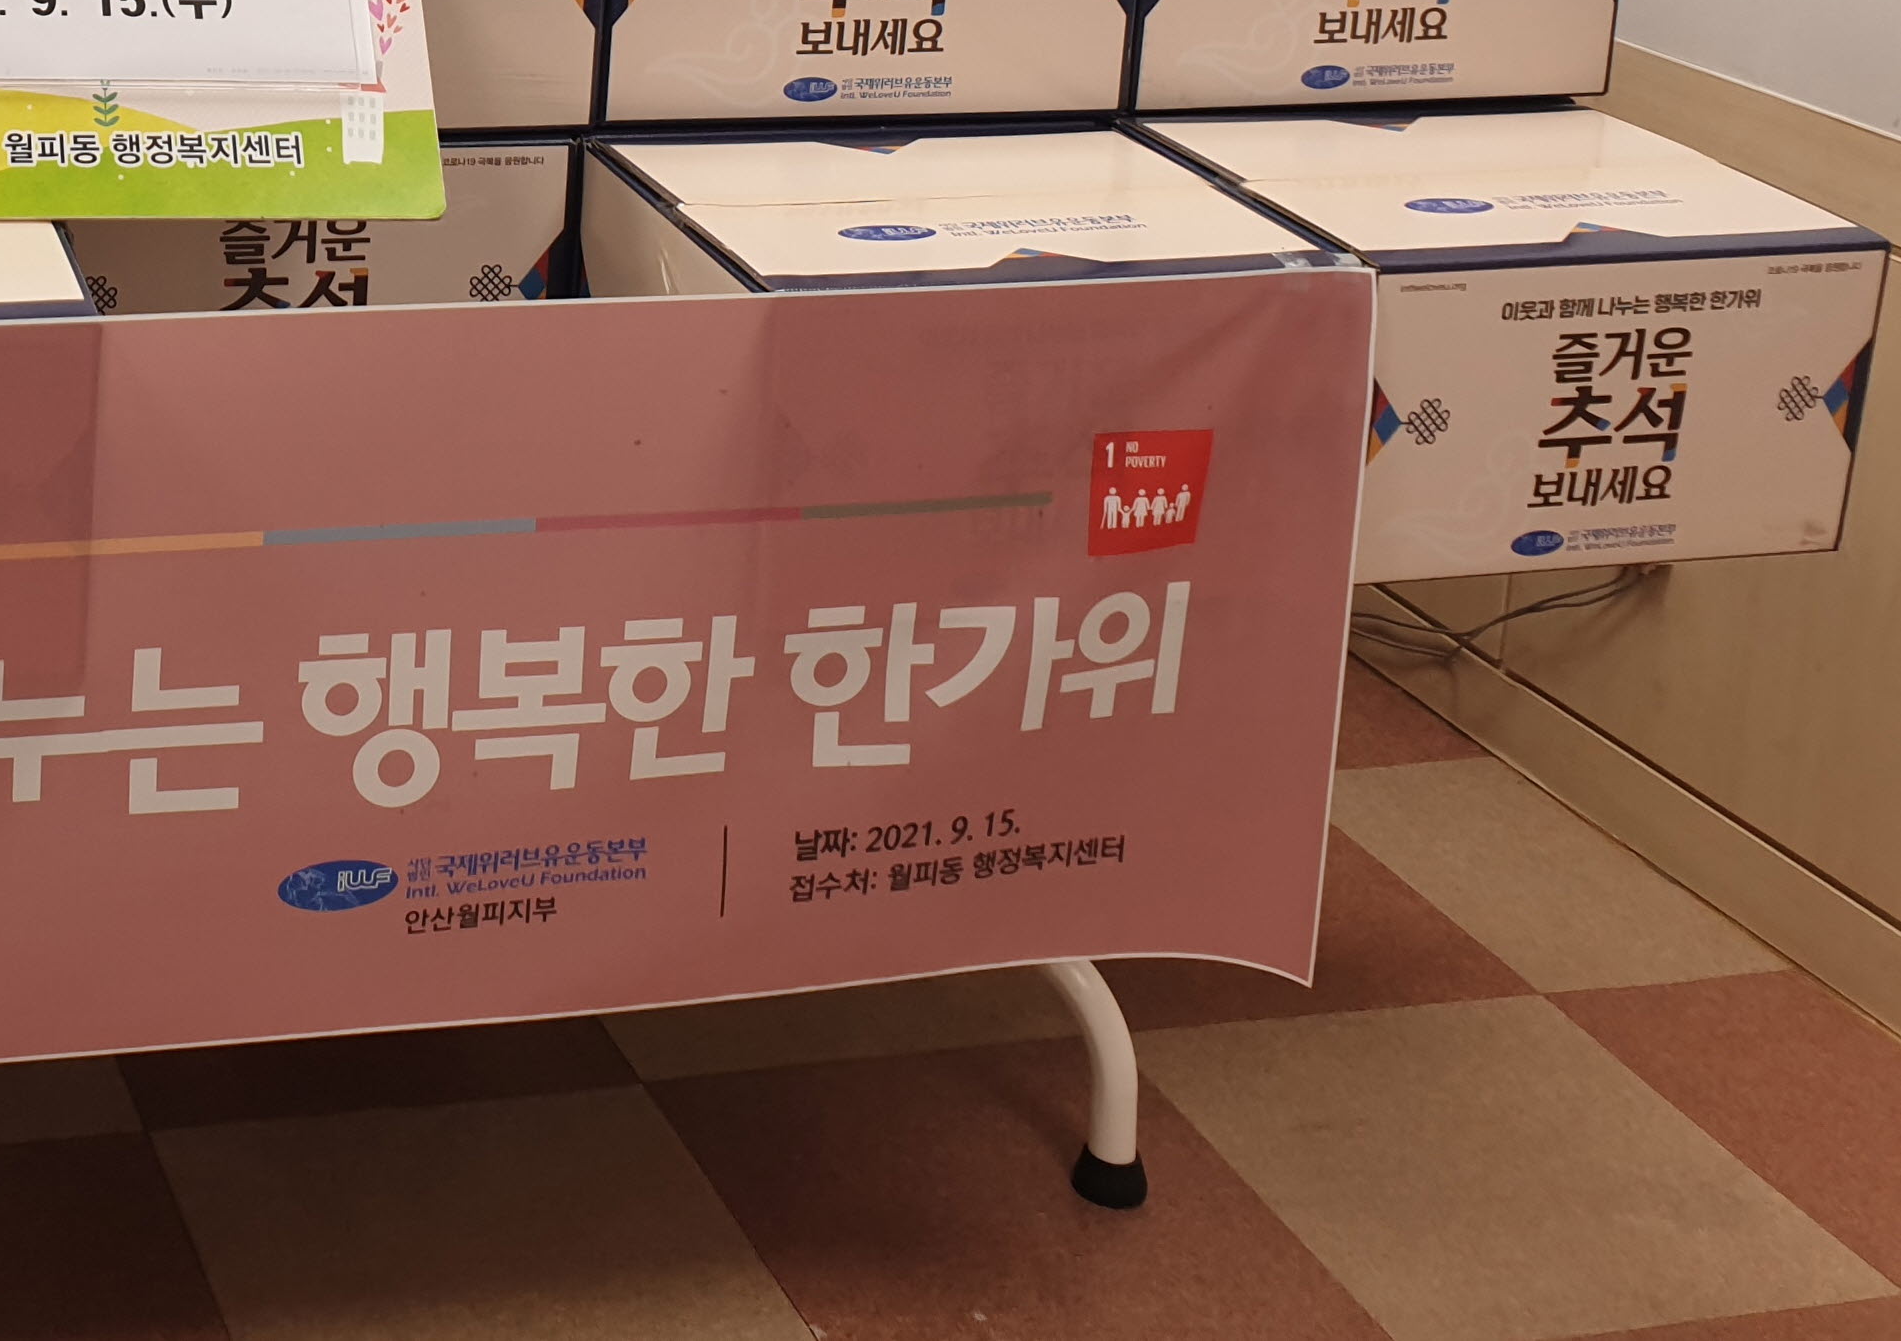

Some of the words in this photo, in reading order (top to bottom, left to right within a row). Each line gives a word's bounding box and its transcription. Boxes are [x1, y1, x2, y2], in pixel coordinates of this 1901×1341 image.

[795, 17, 944, 57] 보내세요
[1313, 7, 1449, 46] 보내세요
[3, 131, 101, 166] 월피동
[111, 132, 303, 167] 행정복지센터
[1552, 326, 1693, 384] 즐거운
[1537, 383, 1690, 470] 추석
[1104, 441, 1115, 469] 1
[1125, 441, 1140, 455] NO
[1125, 454, 1167, 469] POVERTY
[1526, 464, 1673, 509] 보내세요
[298, 615, 755, 809] 행복한
[783, 580, 1191, 769] 한가위
[435, 836, 648, 878] 국제위러브유운동본부
[794, 825, 858, 863] 날짜:
[788, 866, 879, 904] 접수처:
[886, 855, 964, 894] 월피동
[971, 833, 1126, 881] 행정복지센터
[403, 896, 558, 936] 안산월피지부
